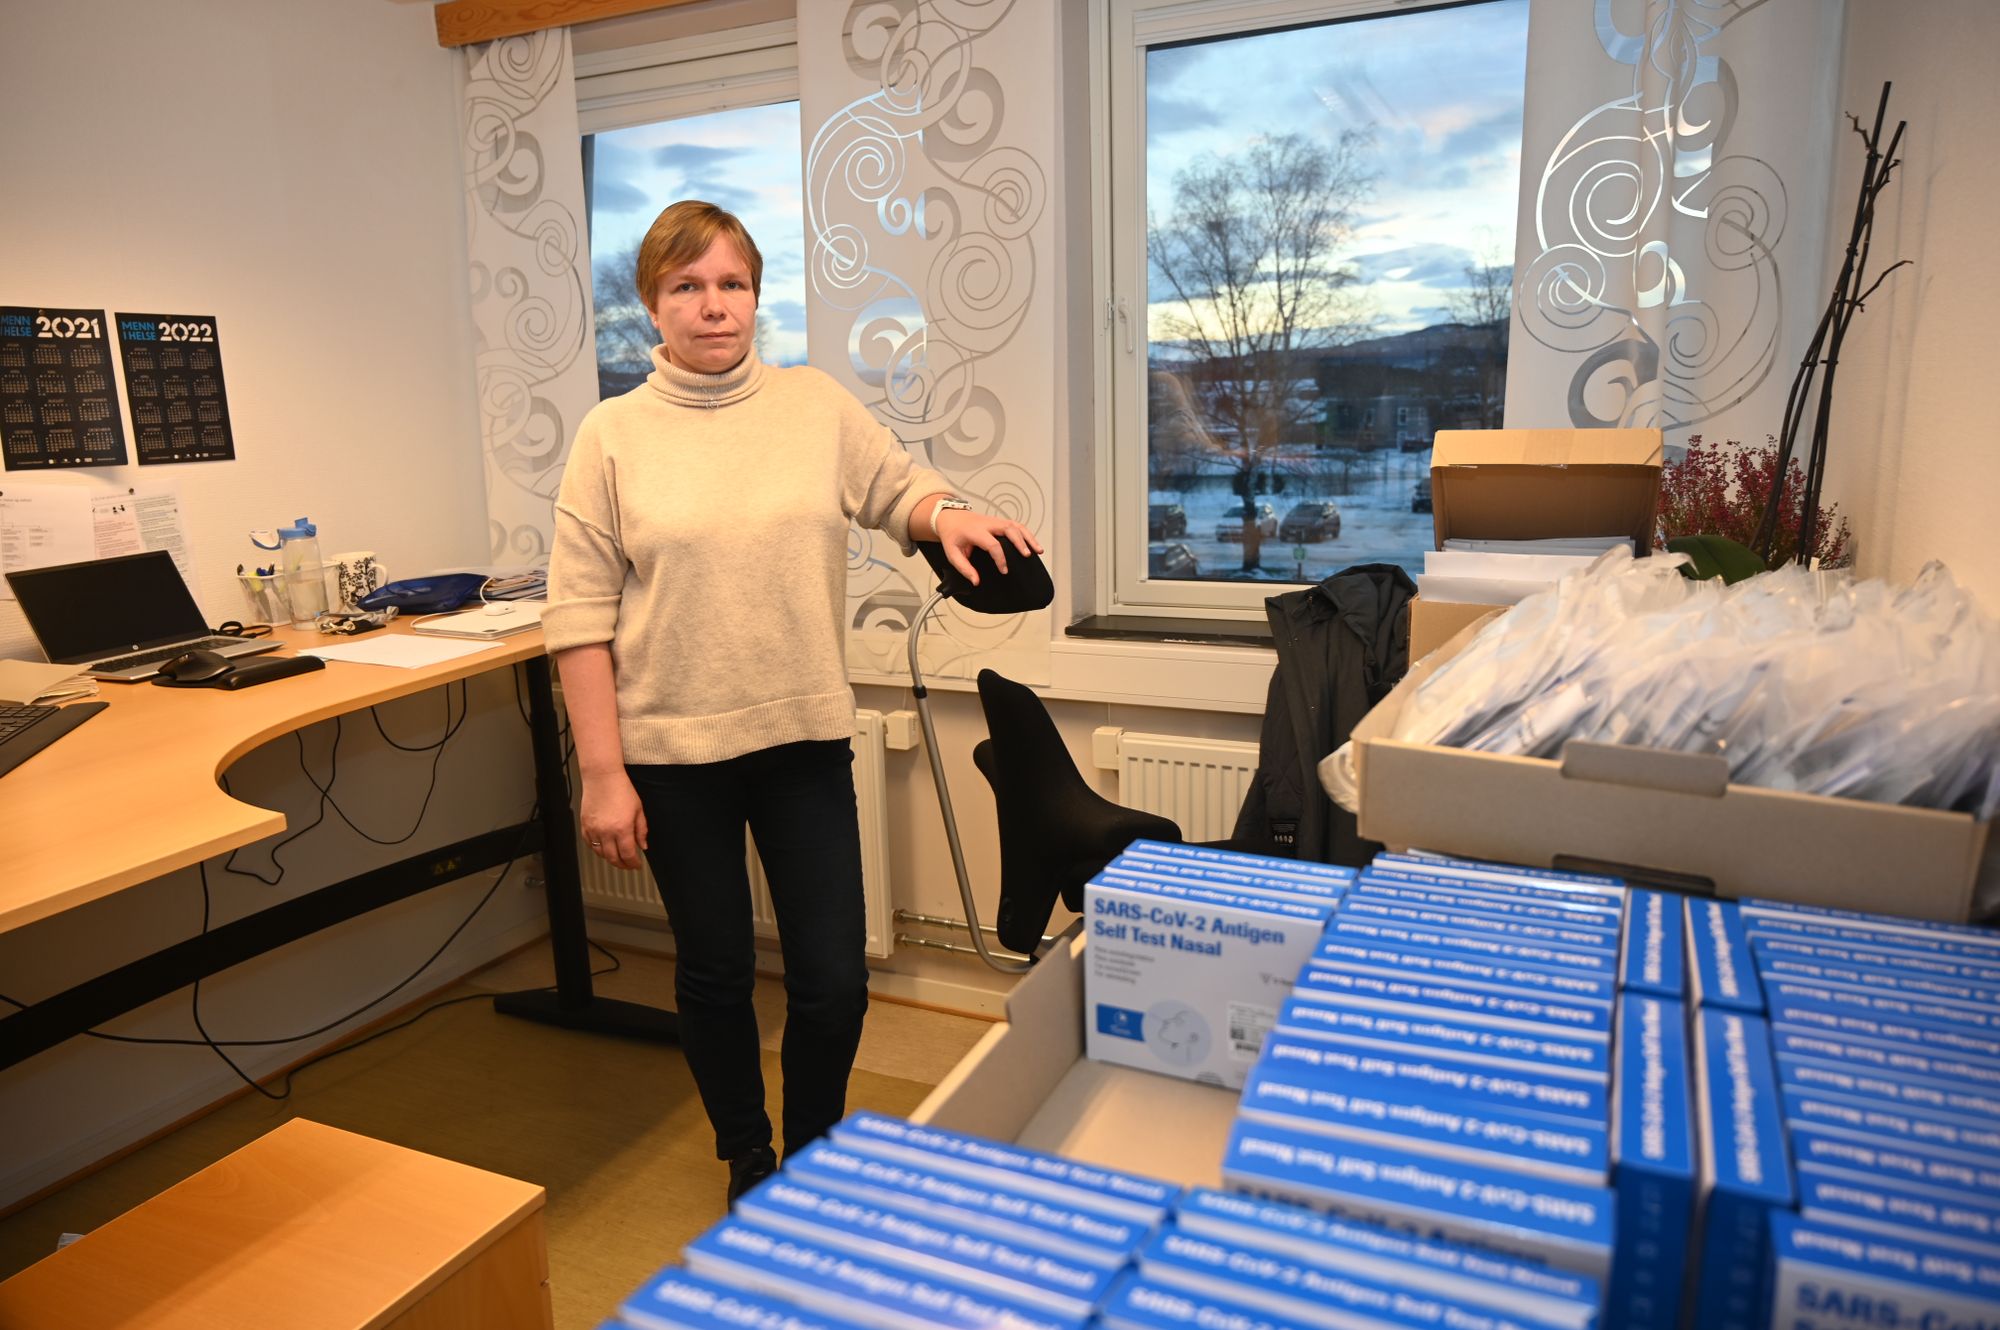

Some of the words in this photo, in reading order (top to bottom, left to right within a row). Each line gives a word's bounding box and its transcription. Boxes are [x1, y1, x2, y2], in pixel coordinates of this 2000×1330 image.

[5, 326, 32, 337] HELSE
[36, 316, 101, 339] 2021
[121, 321, 155, 331] MENN
[128, 331, 157, 341] HELSE
[158, 321, 214, 343] 2022
[1094, 897, 1206, 933] SARS-CoV-2
[1212, 917, 1285, 945] Antigen
[1094, 920, 1127, 940] Self
[1131, 926, 1166, 947] Test
[1170, 933, 1222, 956] Nasal
